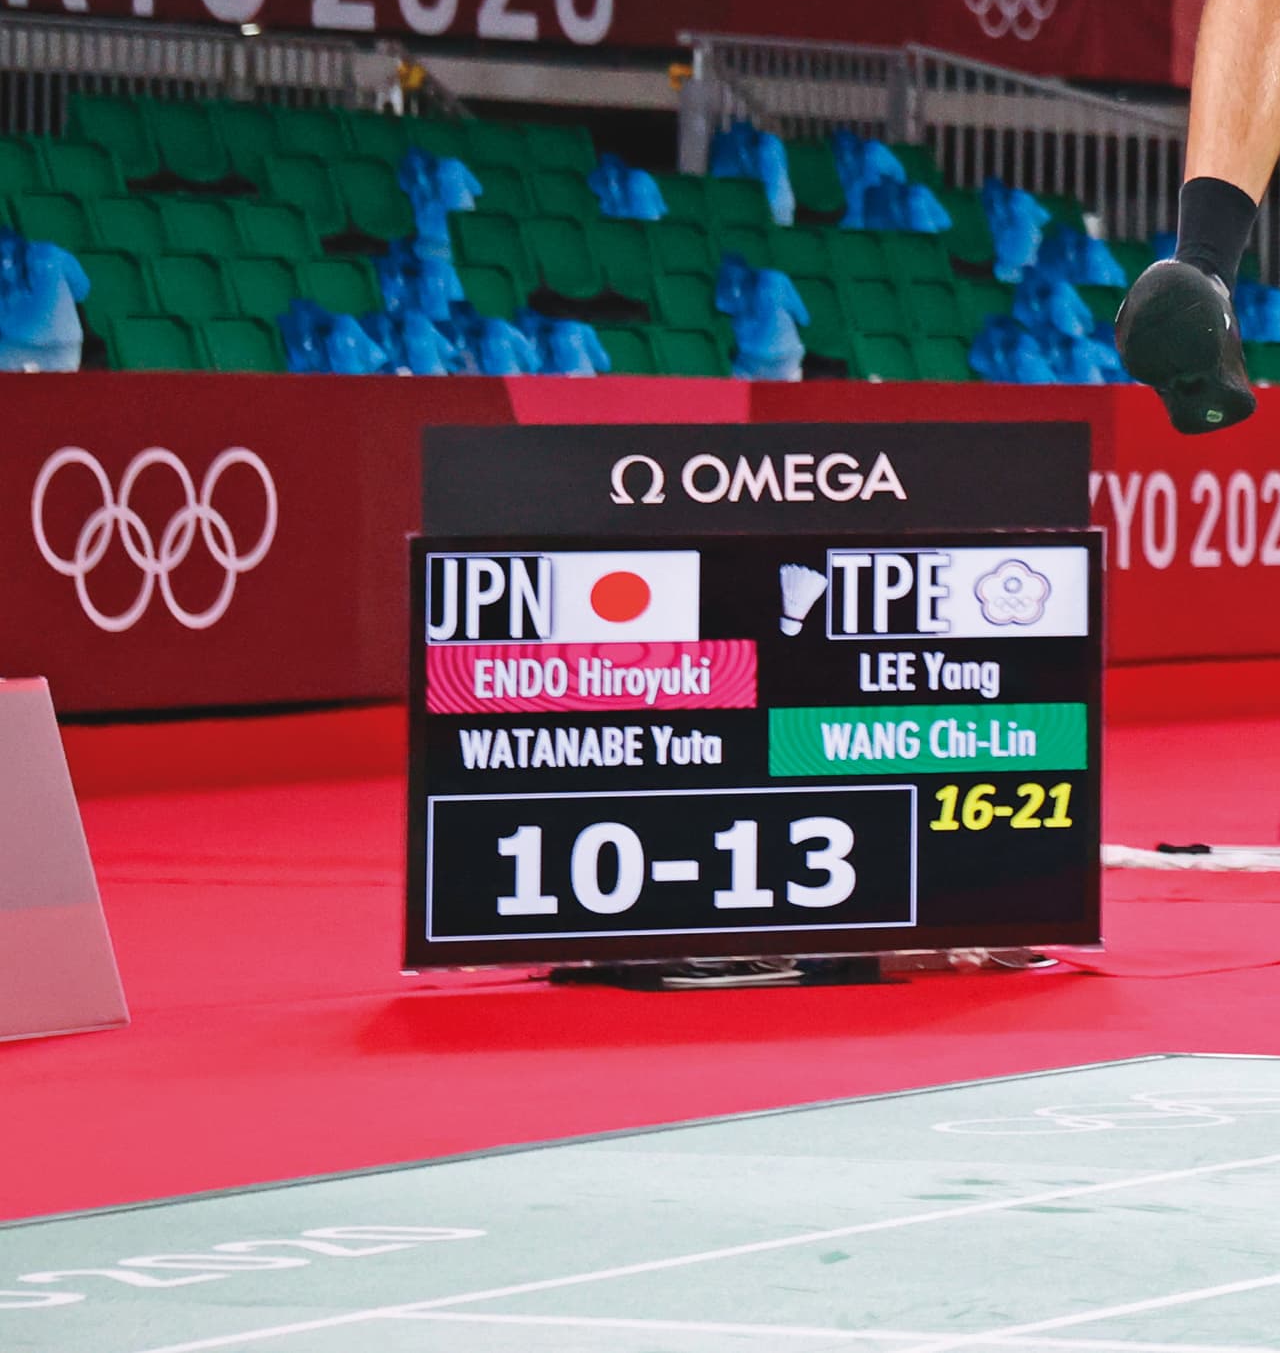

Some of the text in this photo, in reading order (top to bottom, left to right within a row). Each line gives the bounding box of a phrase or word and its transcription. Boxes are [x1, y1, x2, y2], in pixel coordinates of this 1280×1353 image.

[681, 452, 907, 502] OMEGA
[1089, 470, 1178, 570] YO
[428, 558, 552, 641] JPN
[832, 553, 951, 634] TPE
[474, 657, 711, 704] ENDO Hiroyuki
[859, 651, 1000, 698] LEE Yang
[460, 728, 722, 770] WATANABE Yuta
[820, 719, 1037, 761] WANG Chi-Lin
[929, 783, 1074, 831] 16-21
[497, 816, 857, 916] 10-13
[17, 1225, 488, 1288] 2020
